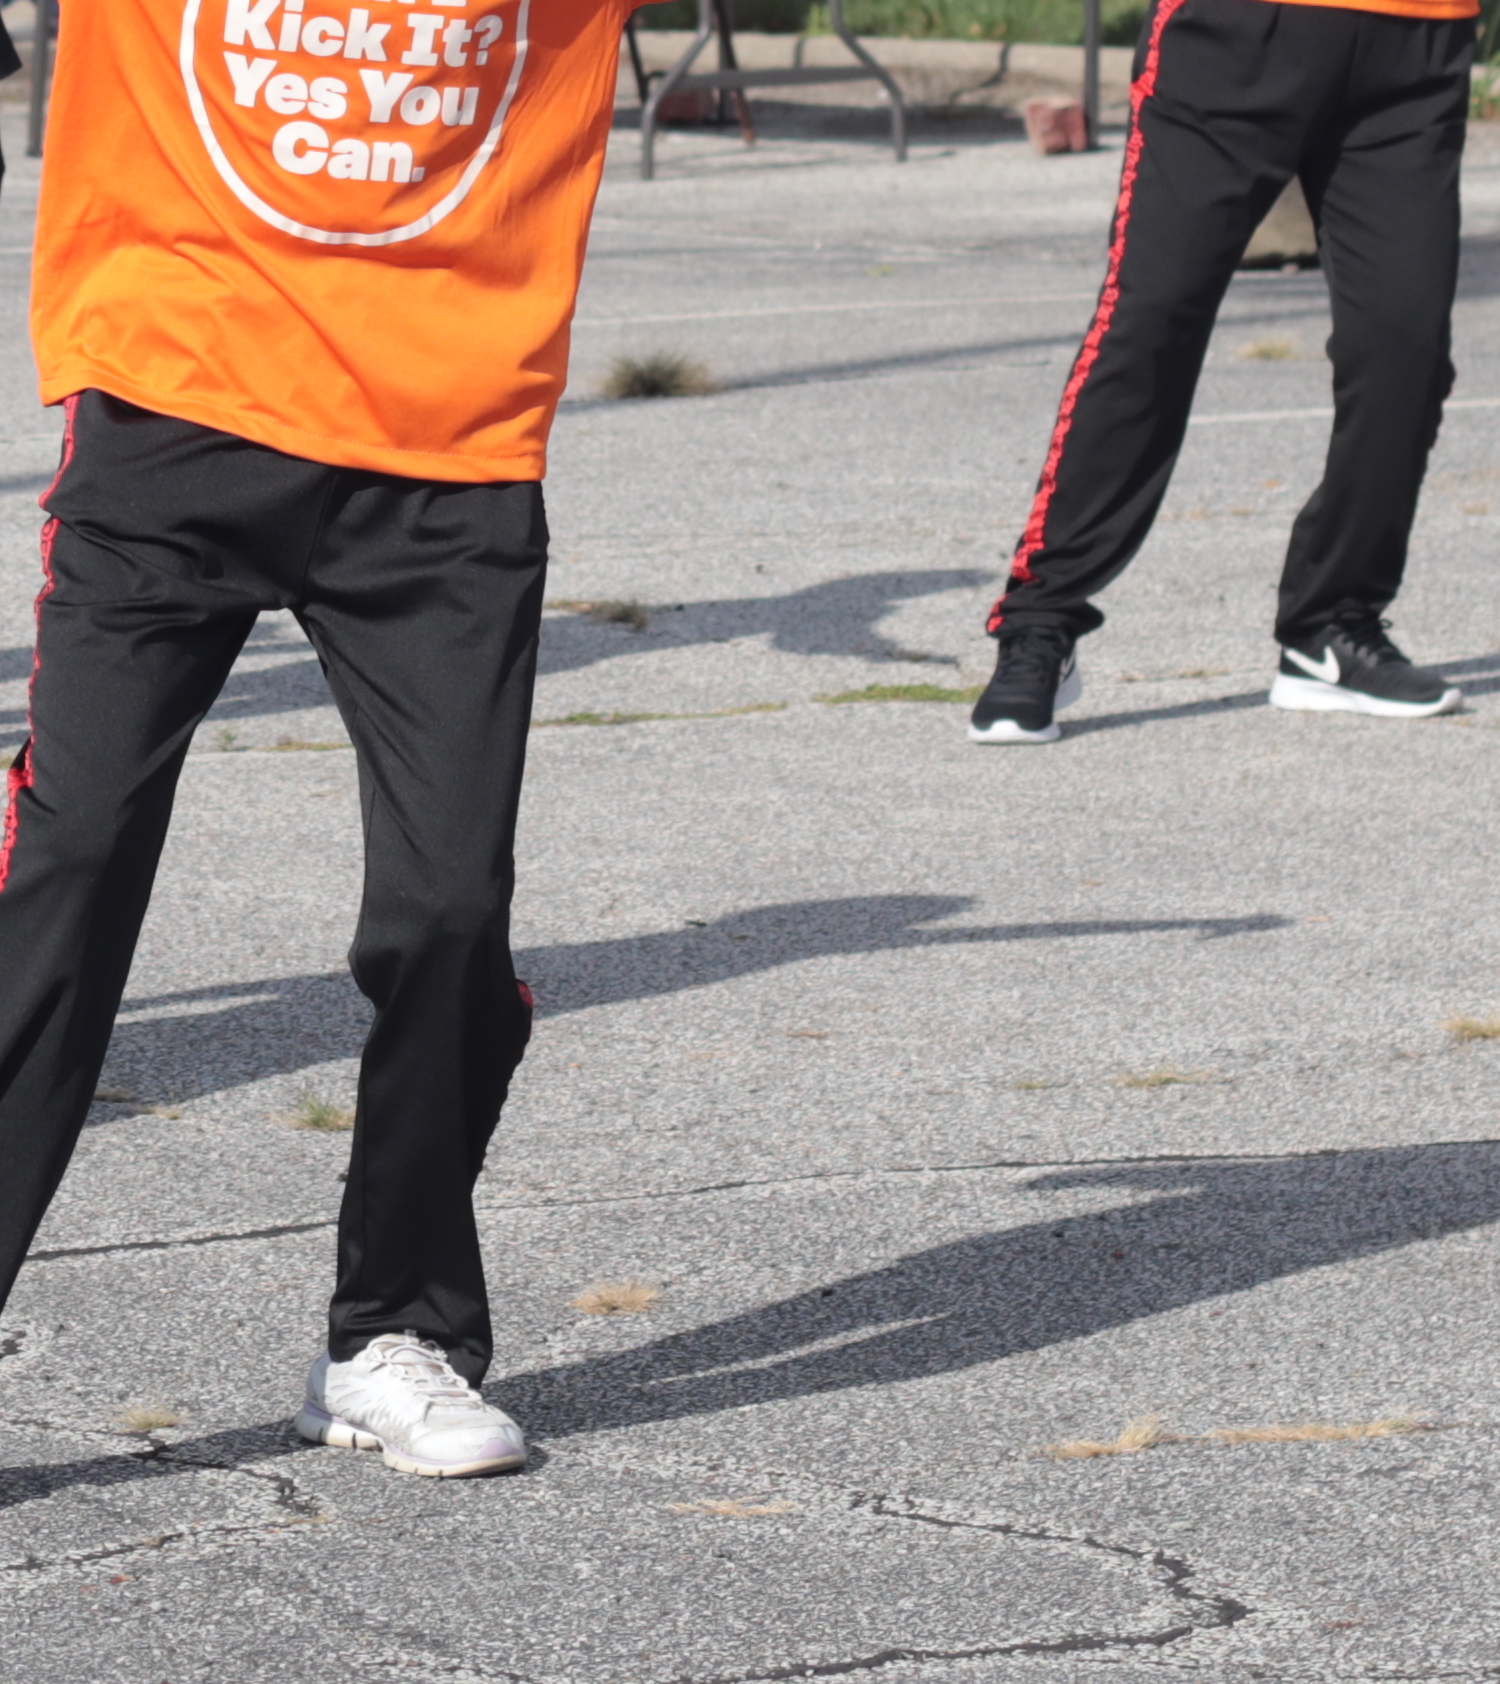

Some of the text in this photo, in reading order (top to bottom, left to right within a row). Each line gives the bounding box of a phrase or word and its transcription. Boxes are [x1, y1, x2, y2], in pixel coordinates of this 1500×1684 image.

[401, 12, 503, 68] It?
[223, 51, 480, 127] Yes You
[272, 120, 425, 183] Can.
